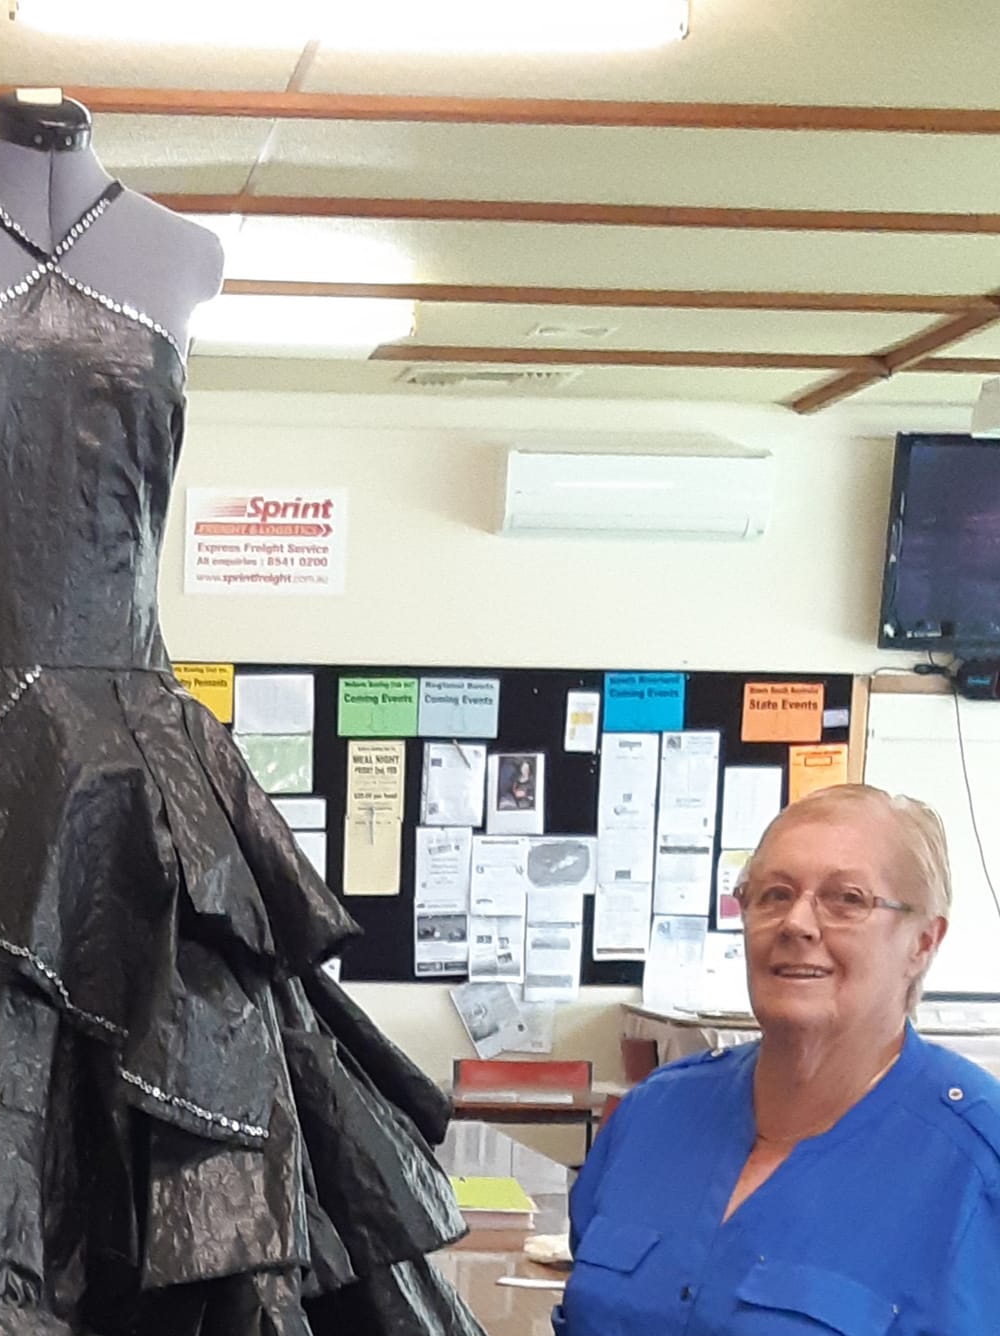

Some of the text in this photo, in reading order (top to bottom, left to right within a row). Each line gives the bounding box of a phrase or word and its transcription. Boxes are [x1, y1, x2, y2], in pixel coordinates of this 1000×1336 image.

[247, 496, 334, 522] Sprint
[197, 542, 329, 555] Express Freight Service
[267, 557, 295, 566] 8541
[344, 693, 413, 705] Coming Events
[609, 688, 679, 699] Coming Events
[425, 694, 494, 706] Coming Events
[749, 699, 818, 711] State Events
